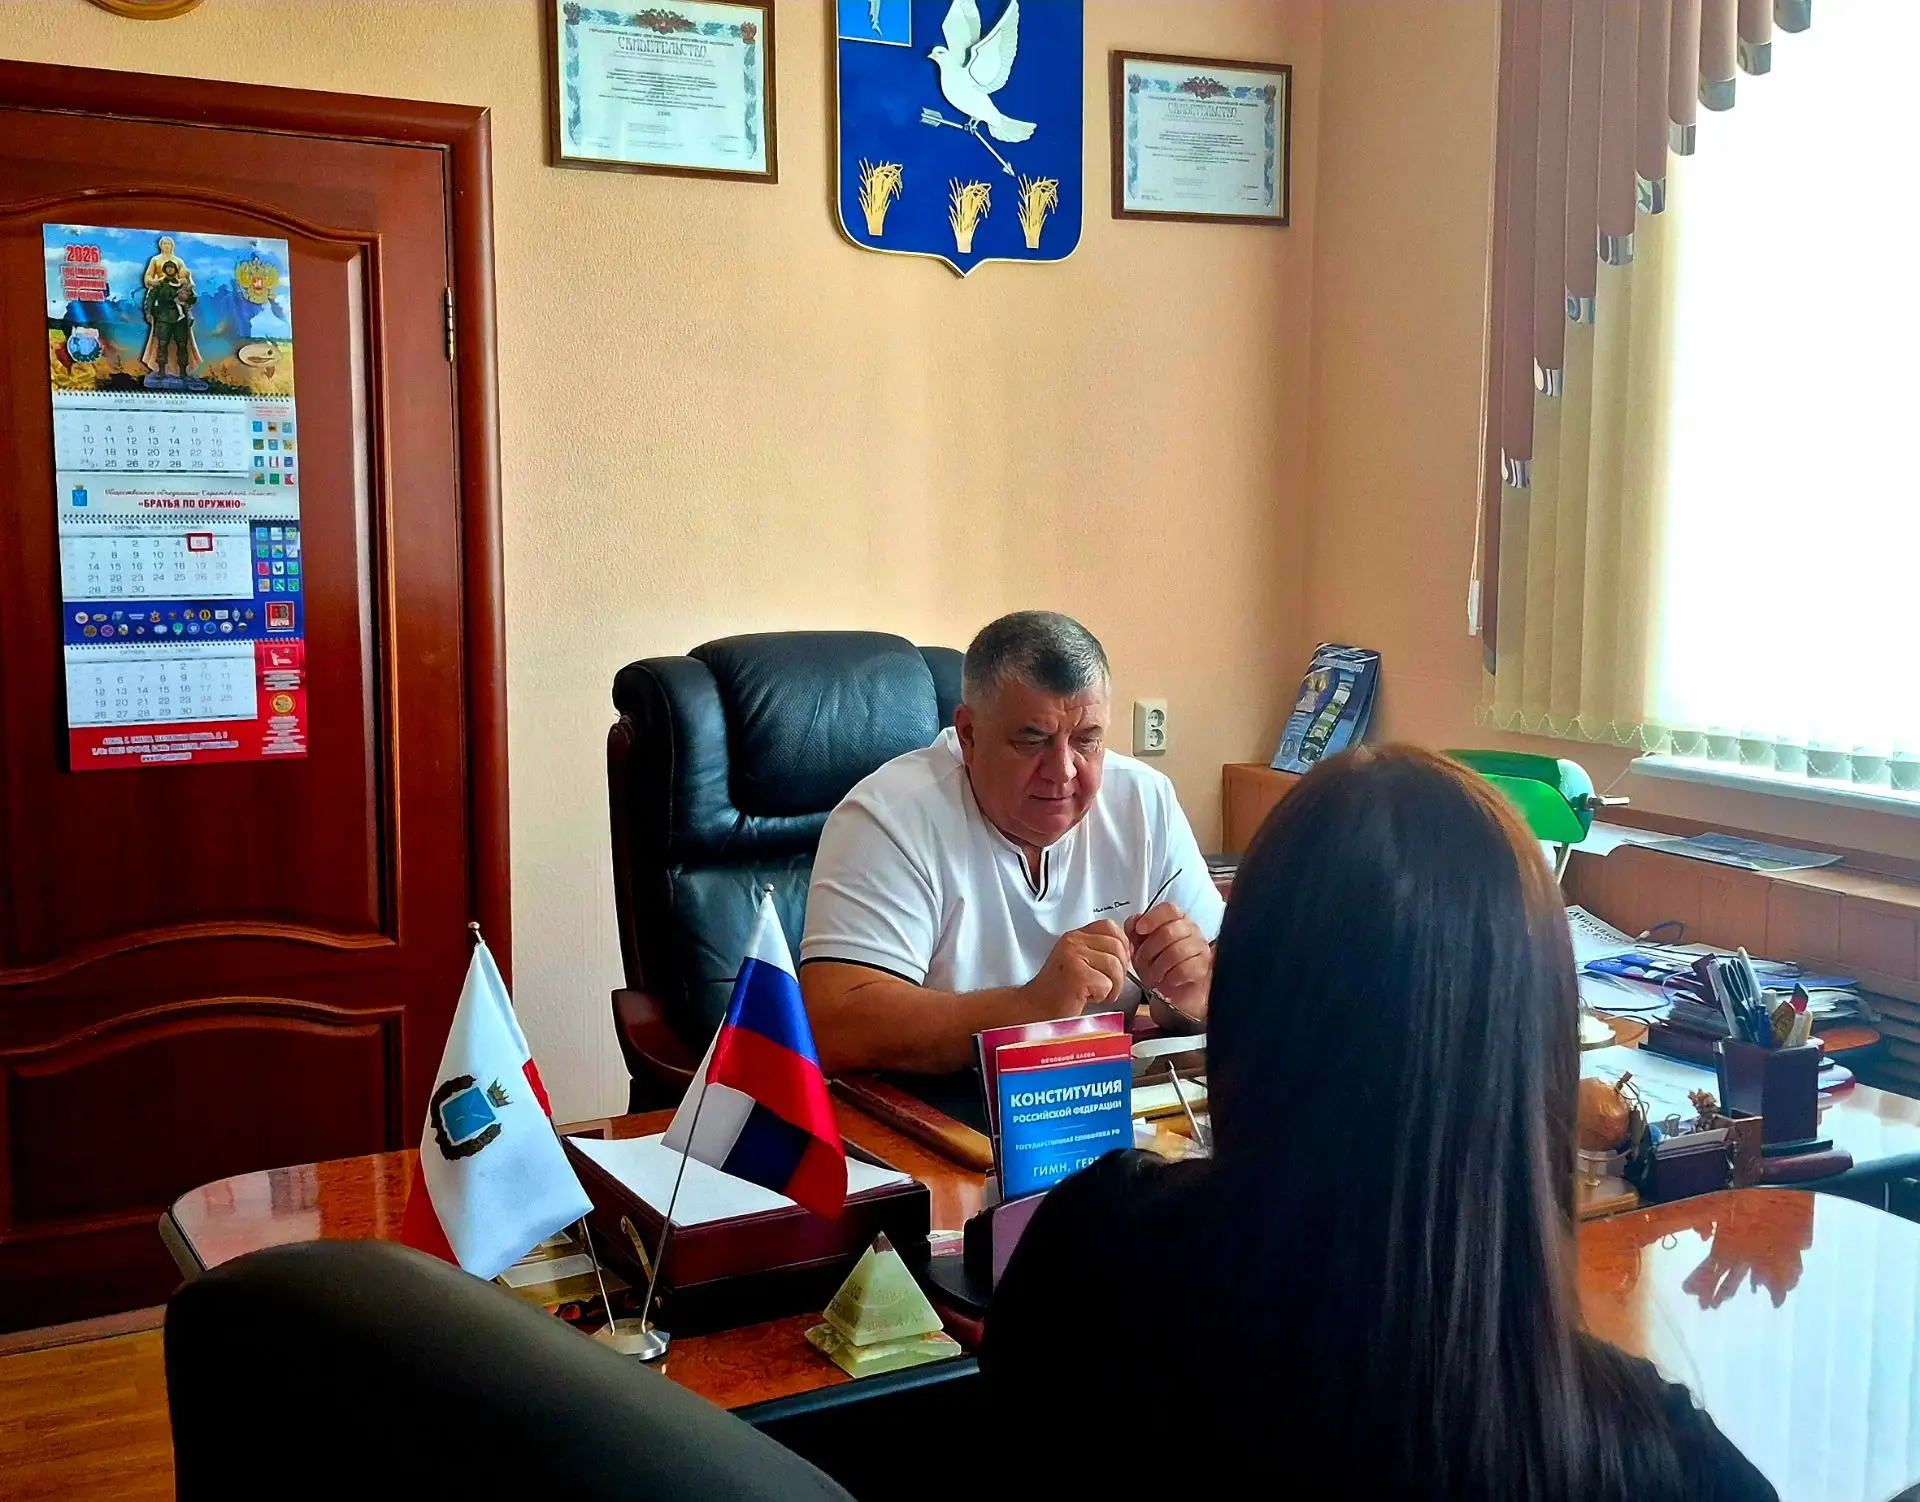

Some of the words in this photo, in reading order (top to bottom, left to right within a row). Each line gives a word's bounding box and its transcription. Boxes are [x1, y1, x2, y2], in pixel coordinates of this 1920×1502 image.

[66, 245, 99, 263] 2026
[84, 424, 90, 432] 3
[83, 436, 94, 444] 10
[104, 436, 114, 444] 11
[148, 437, 159, 445] 13
[84, 448, 94, 456] 17
[105, 448, 116, 456] 18
[148, 447, 160, 456] 20
[148, 459, 160, 468] 27
[170, 460, 181, 468] 28
[138, 499, 180, 508] «БРАТЬЯ
[182, 499, 195, 508] ПО
[198, 499, 246, 508] ОРУЖИЮ»
[90, 552, 96, 560] 7
[153, 551, 164, 559] 10
[132, 562, 143, 570] 16
[154, 562, 163, 570] 17
[174, 561, 185, 569] 18
[88, 574, 99, 582] 21
[110, 574, 121, 582] 22
[132, 573, 143, 582] 23
[153, 573, 164, 581] 24
[174, 572, 185, 581] 25
[89, 586, 100, 594] 28
[110, 585, 122, 593] 29
[133, 585, 144, 593] 30
[180, 663, 186, 671] 2
[117, 676, 123, 684] 6
[160, 674, 166, 683] 8
[159, 684, 170, 693] 15
[116, 699, 128, 708] 20
[137, 698, 148, 706] 21
[158, 696, 170, 704] 22
[179, 696, 191, 704] 23
[95, 711, 106, 719] 26
[116, 710, 128, 719] 27
[138, 709, 149, 717] 28
[159, 708, 171, 716] 29
[1010, 1079, 1122, 1108] КОНСТИТУЦИЯ
[1013, 1107, 1072, 1123] РОССИЙСКОЙ
[1073, 1100, 1122, 1116] ФЕДЕРАЦИИ
[1015, 1135, 1074, 1151] ГОСУДАРСТВЕННАЯ
[1074, 1130, 1111, 1142] СИМВОЛИКА
[1111, 1128, 1121, 1137] РФ
[1033, 1162, 1071, 1177] ГИМН,
[1075, 1156, 1100, 1169] ГЕР
